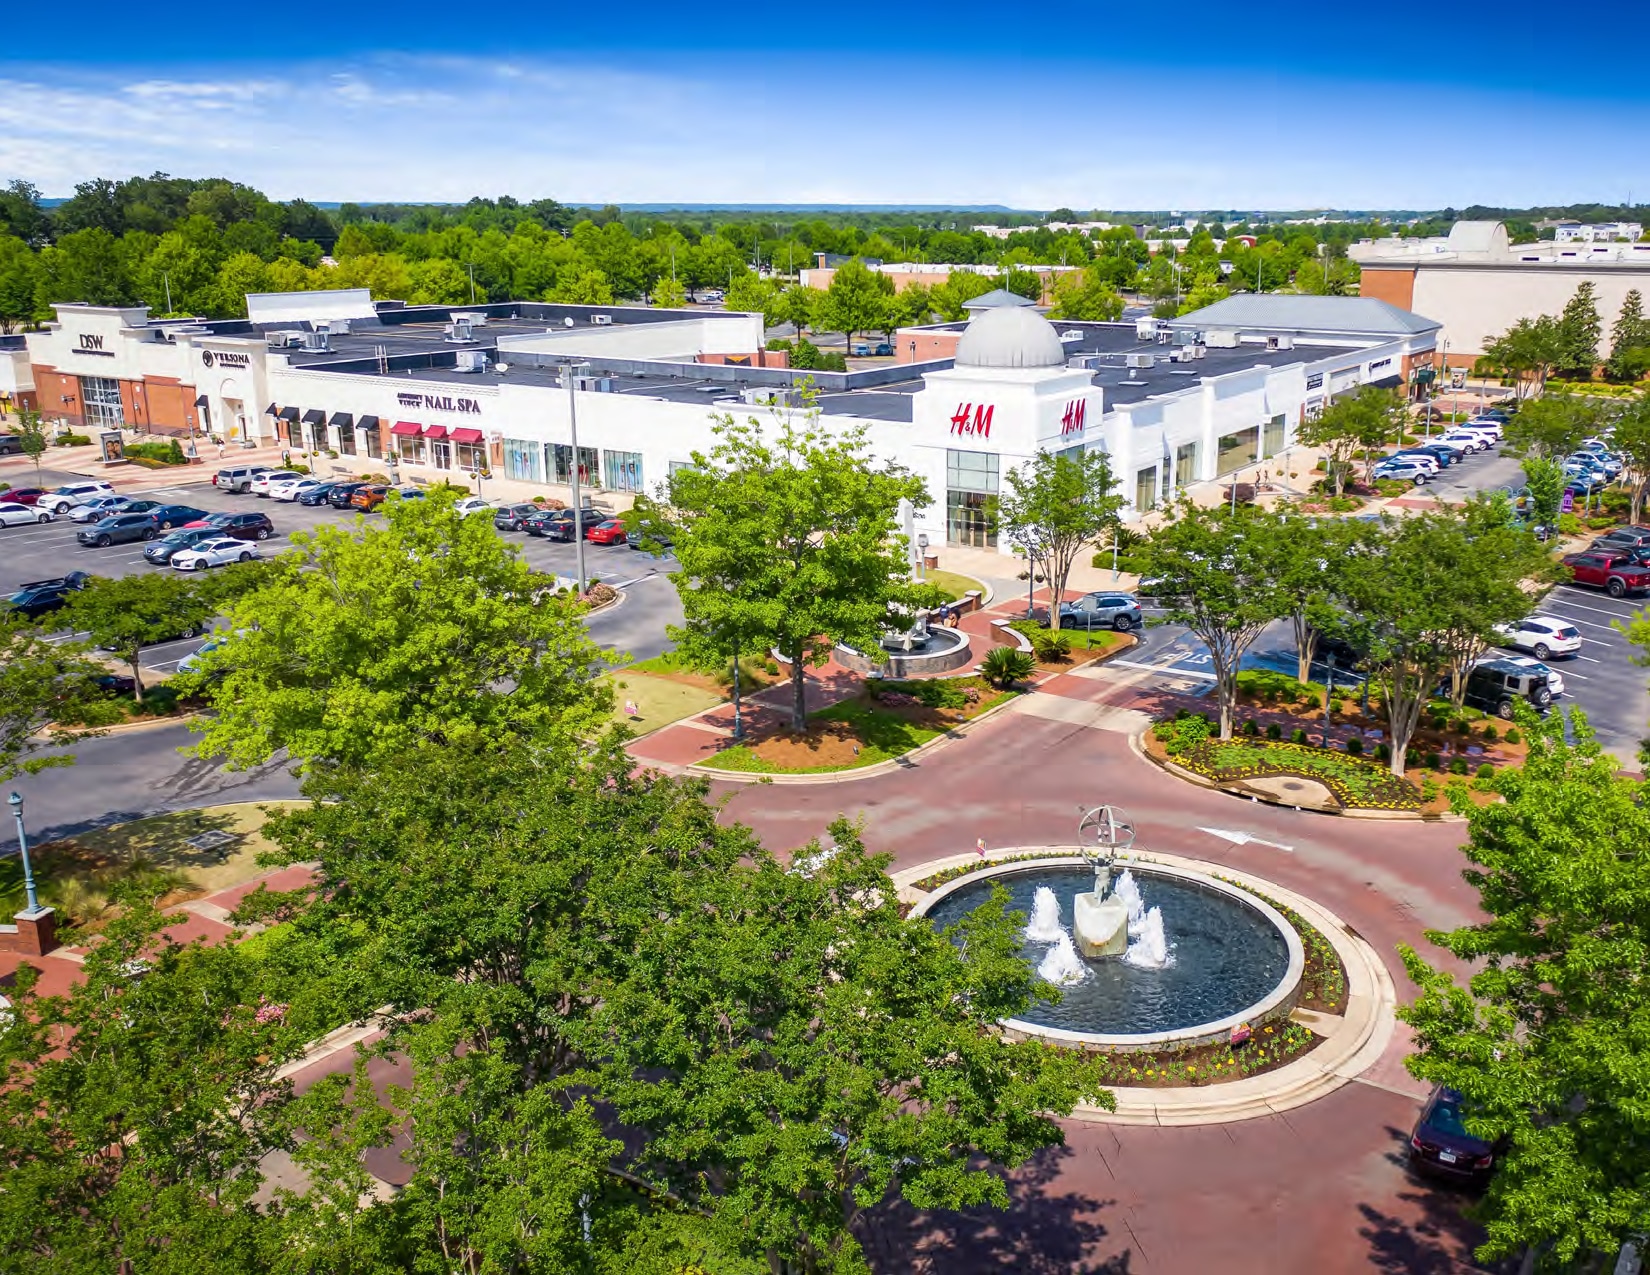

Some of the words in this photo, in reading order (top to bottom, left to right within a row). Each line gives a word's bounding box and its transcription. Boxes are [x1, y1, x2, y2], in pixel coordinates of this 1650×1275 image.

[79, 333, 103, 349] DSW
[425, 395, 456, 411] NAIL
[457, 398, 480, 413] SPA
[1061, 398, 1086, 435] H&M
[950, 402, 995, 438] H&M
